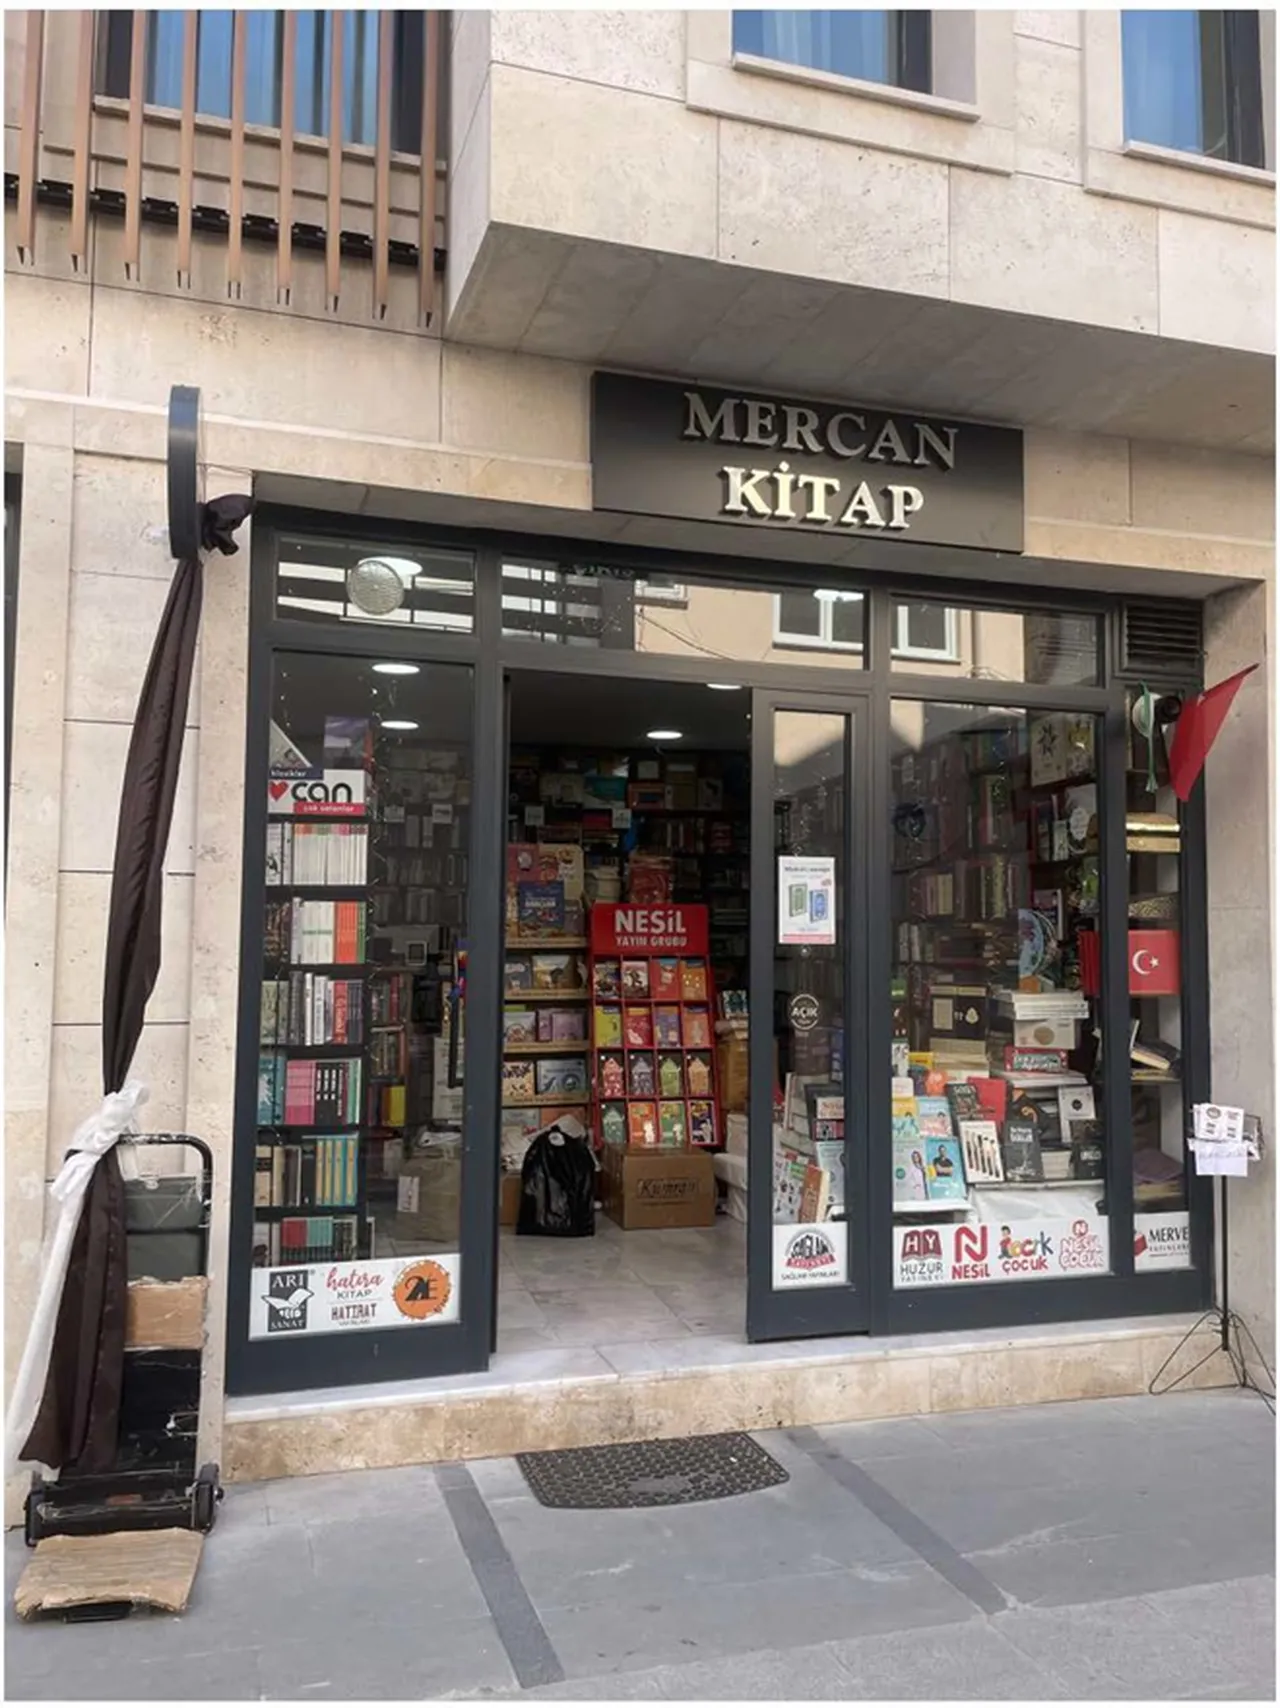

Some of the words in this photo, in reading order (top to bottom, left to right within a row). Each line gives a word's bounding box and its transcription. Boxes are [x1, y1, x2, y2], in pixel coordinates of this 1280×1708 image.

[683, 391, 958, 471] MERCAN
[720, 460, 925, 530] KİTAP
[291, 782, 352, 803] can
[1149, 1226, 1189, 1242] MERVE
[900, 1262, 943, 1275] HUZUR
[272, 1273, 305, 1289] ARI
[331, 1302, 378, 1321] HATIRAT
[270, 1320, 303, 1330] SANAT
